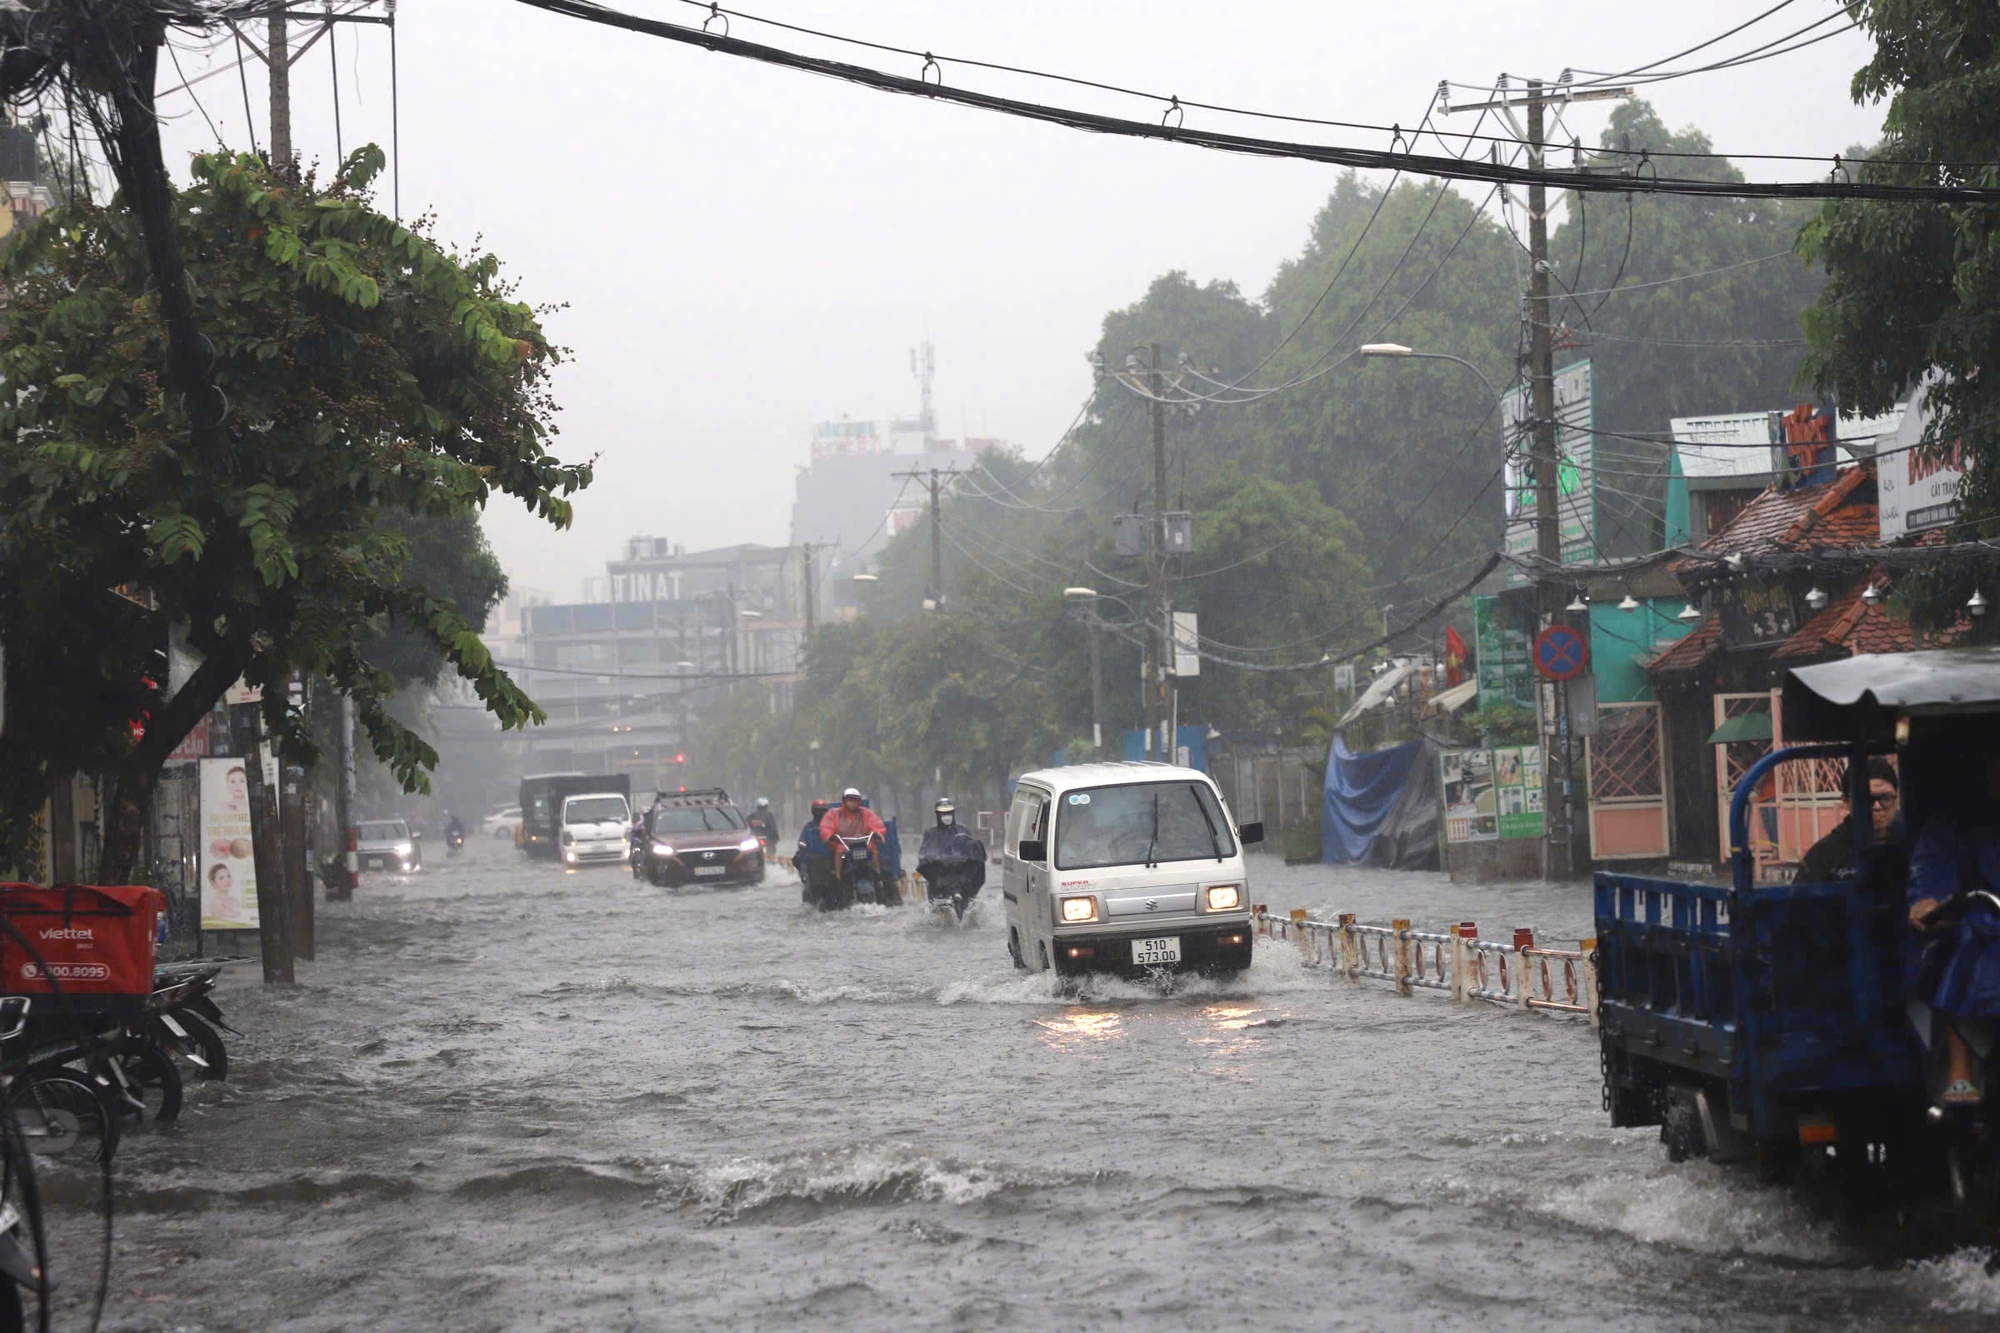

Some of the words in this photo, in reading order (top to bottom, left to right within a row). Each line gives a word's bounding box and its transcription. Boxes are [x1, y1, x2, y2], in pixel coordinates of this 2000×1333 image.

[40, 928, 94, 940] viettel
[1145, 939, 1167, 951] 51D
[1138, 950, 1176, 963] 573.00
